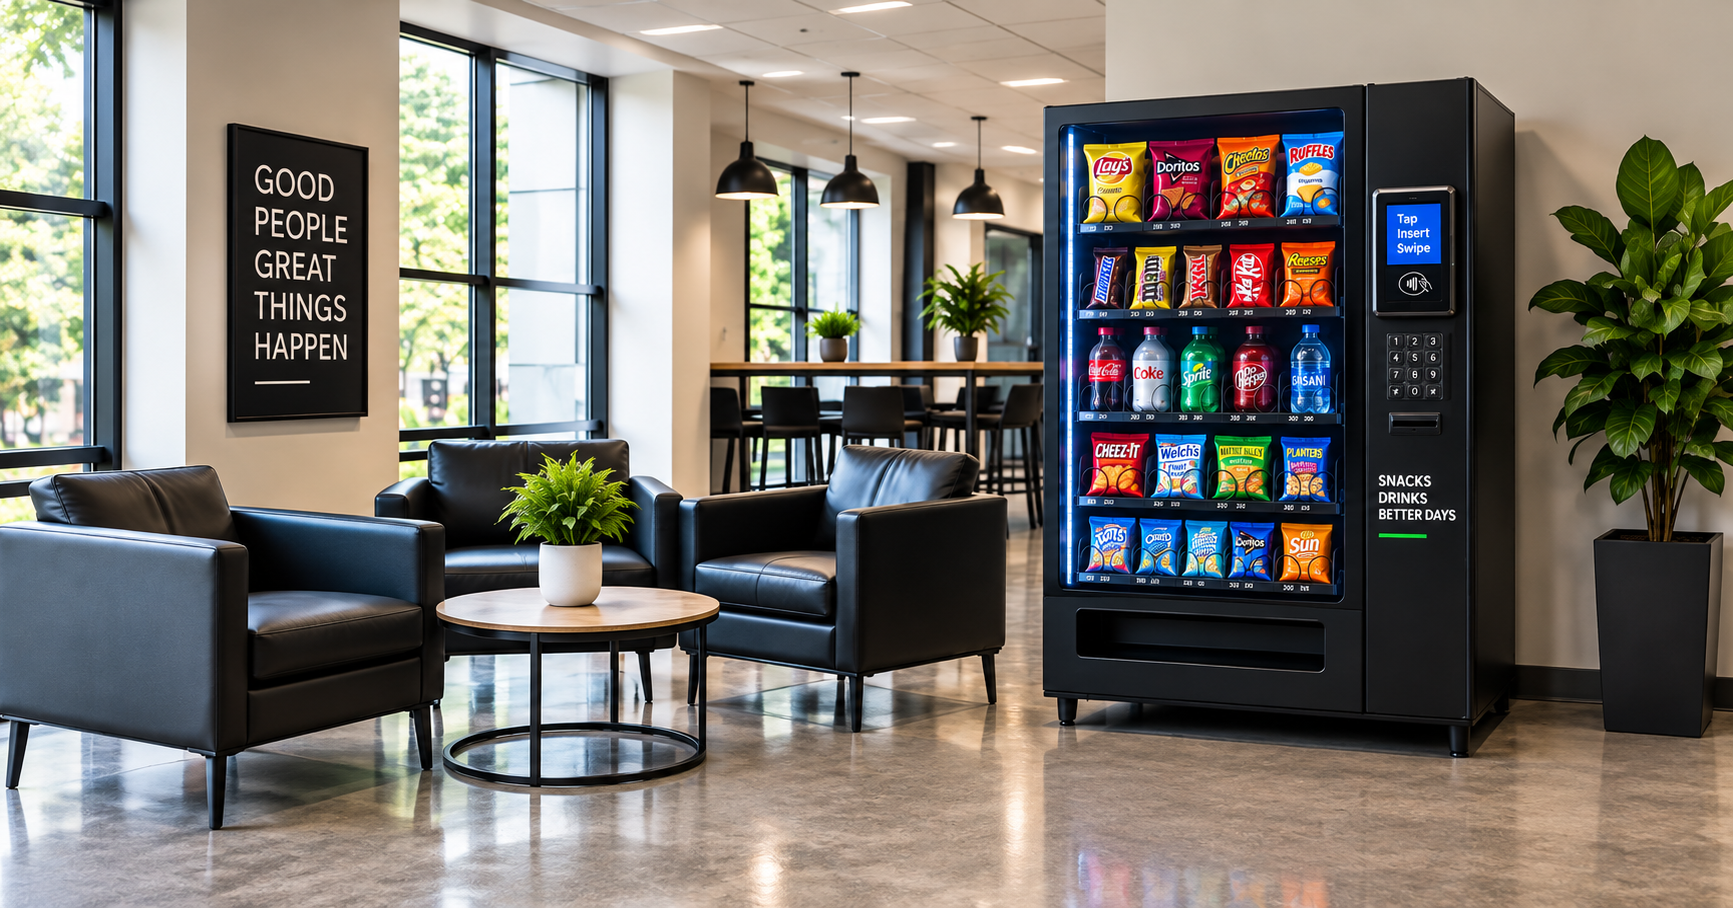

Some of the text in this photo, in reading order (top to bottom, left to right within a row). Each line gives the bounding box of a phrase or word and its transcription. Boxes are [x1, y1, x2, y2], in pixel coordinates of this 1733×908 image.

[1289, 144, 1334, 165] RUFFLES
[1157, 160, 1200, 174] Doritos
[254, 164, 335, 202] GOOD
[255, 206, 348, 244] PEOPLE
[1397, 213, 1418, 226] Tap
[1397, 228, 1430, 239] Insert
[1397, 242, 1431, 256] Swipe
[254, 249, 337, 282] GREAT
[254, 291, 347, 322] THINGS
[255, 332, 348, 360] HAPPEN
[1412, 337, 1418, 346] 2
[1430, 337, 1436, 346] 3
[1393, 353, 1399, 362] 4
[1430, 353, 1436, 362] 6
[1133, 366, 1164, 380] Coke
[1182, 366, 1212, 388] Sprite
[1393, 370, 1436, 379] 7 8 9
[1411, 387, 1418, 396] 0
[1160, 444, 1199, 460] Welch's
[1378, 474, 1432, 488] SNACKS
[1378, 491, 1428, 505] DRINKS
[1378, 508, 1457, 522] BETTER DAYS
[1289, 537, 1320, 554] Sun
